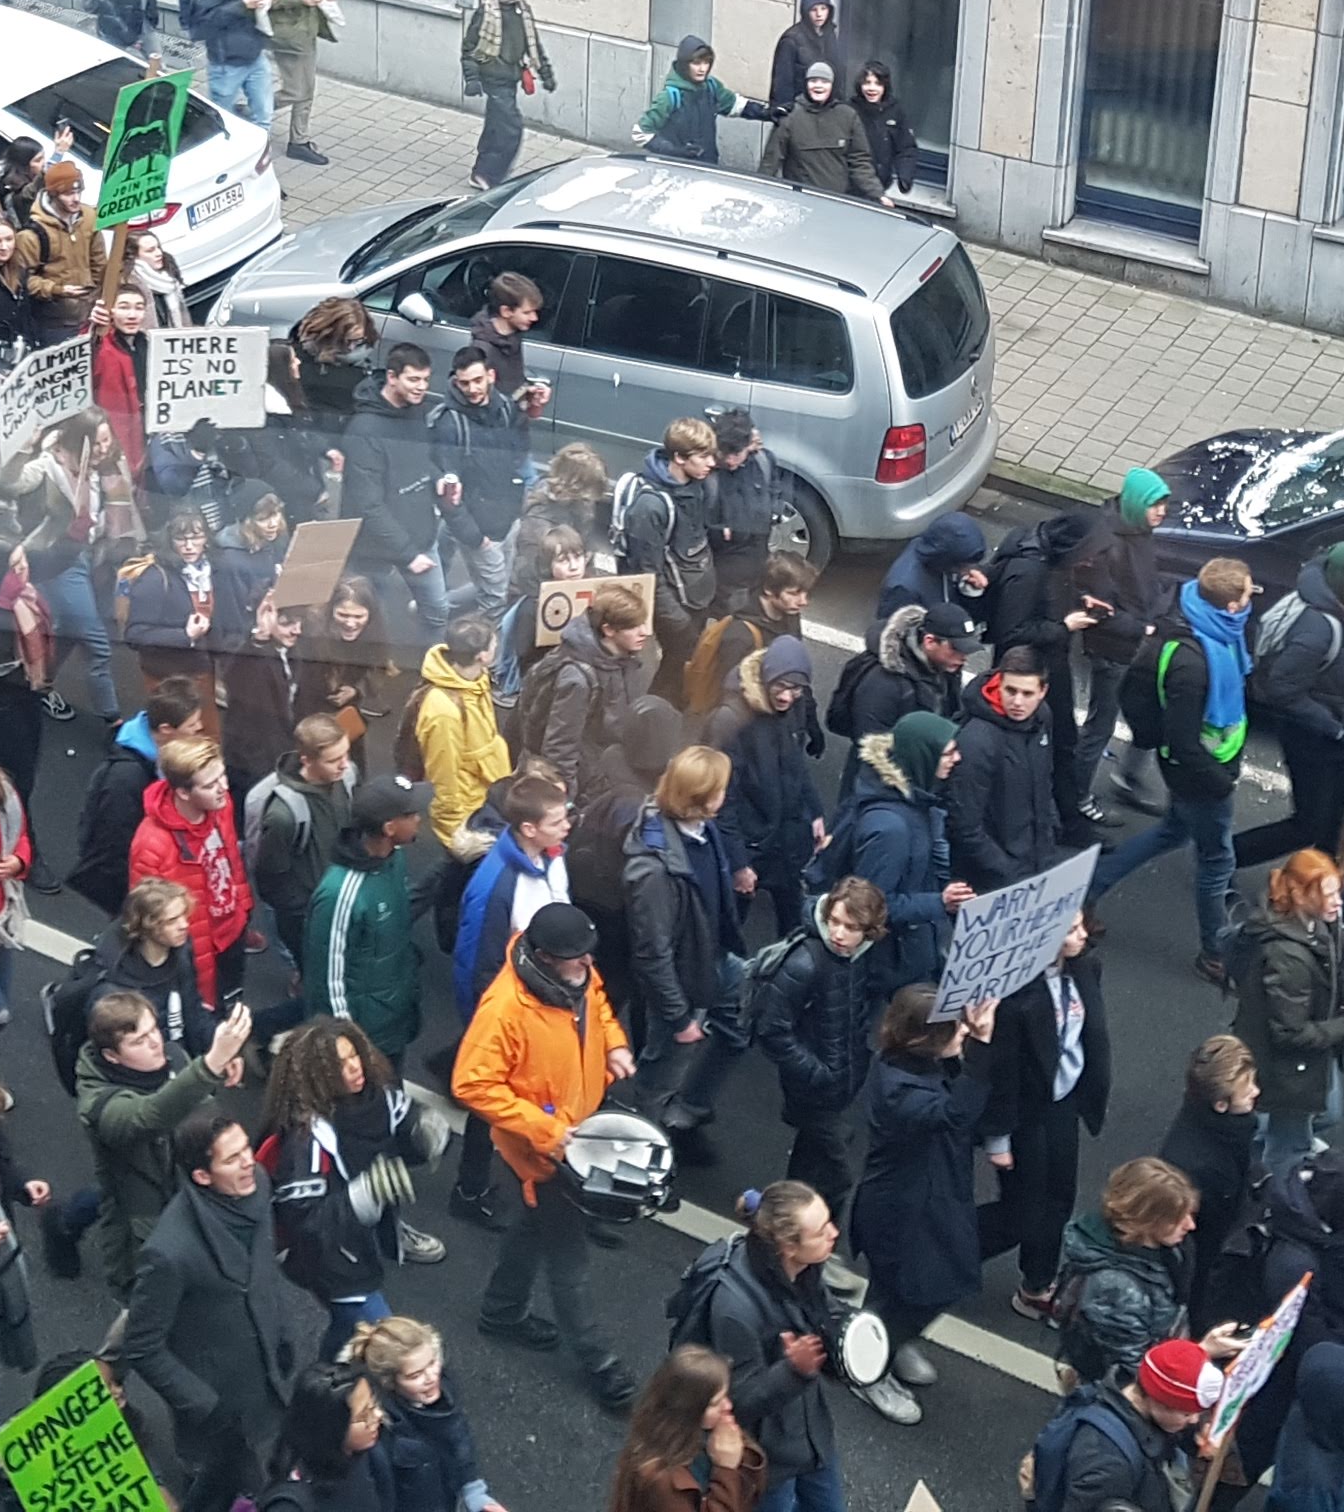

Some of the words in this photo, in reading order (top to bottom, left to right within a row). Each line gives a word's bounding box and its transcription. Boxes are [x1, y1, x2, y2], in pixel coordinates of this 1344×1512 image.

[98, 193, 143, 219] GREEN
[113, 182, 140, 197] JOIN
[164, 336, 238, 354] THERE
[1, 372, 26, 405] THE
[27, 341, 91, 377] CLIMATE
[17, 360, 89, 408] CHANGING
[163, 358, 193, 375] IS
[206, 358, 236, 374] NO
[158, 379, 243, 401] PLANET
[2, 407, 30, 439] WHY
[157, 402, 170, 424] B
[962, 877, 1047, 933] WARM
[943, 951, 1004, 989] NOT
[1005, 923, 1062, 969] THE
[953, 917, 1021, 962] YOUR
[939, 956, 1037, 1013] EARTH
[4, 1375, 112, 1474] CHANGEZ
[29, 1421, 135, 1512] SYSTEME
[50, 1434, 81, 1470] LE
[94, 1462, 131, 1498] LE
